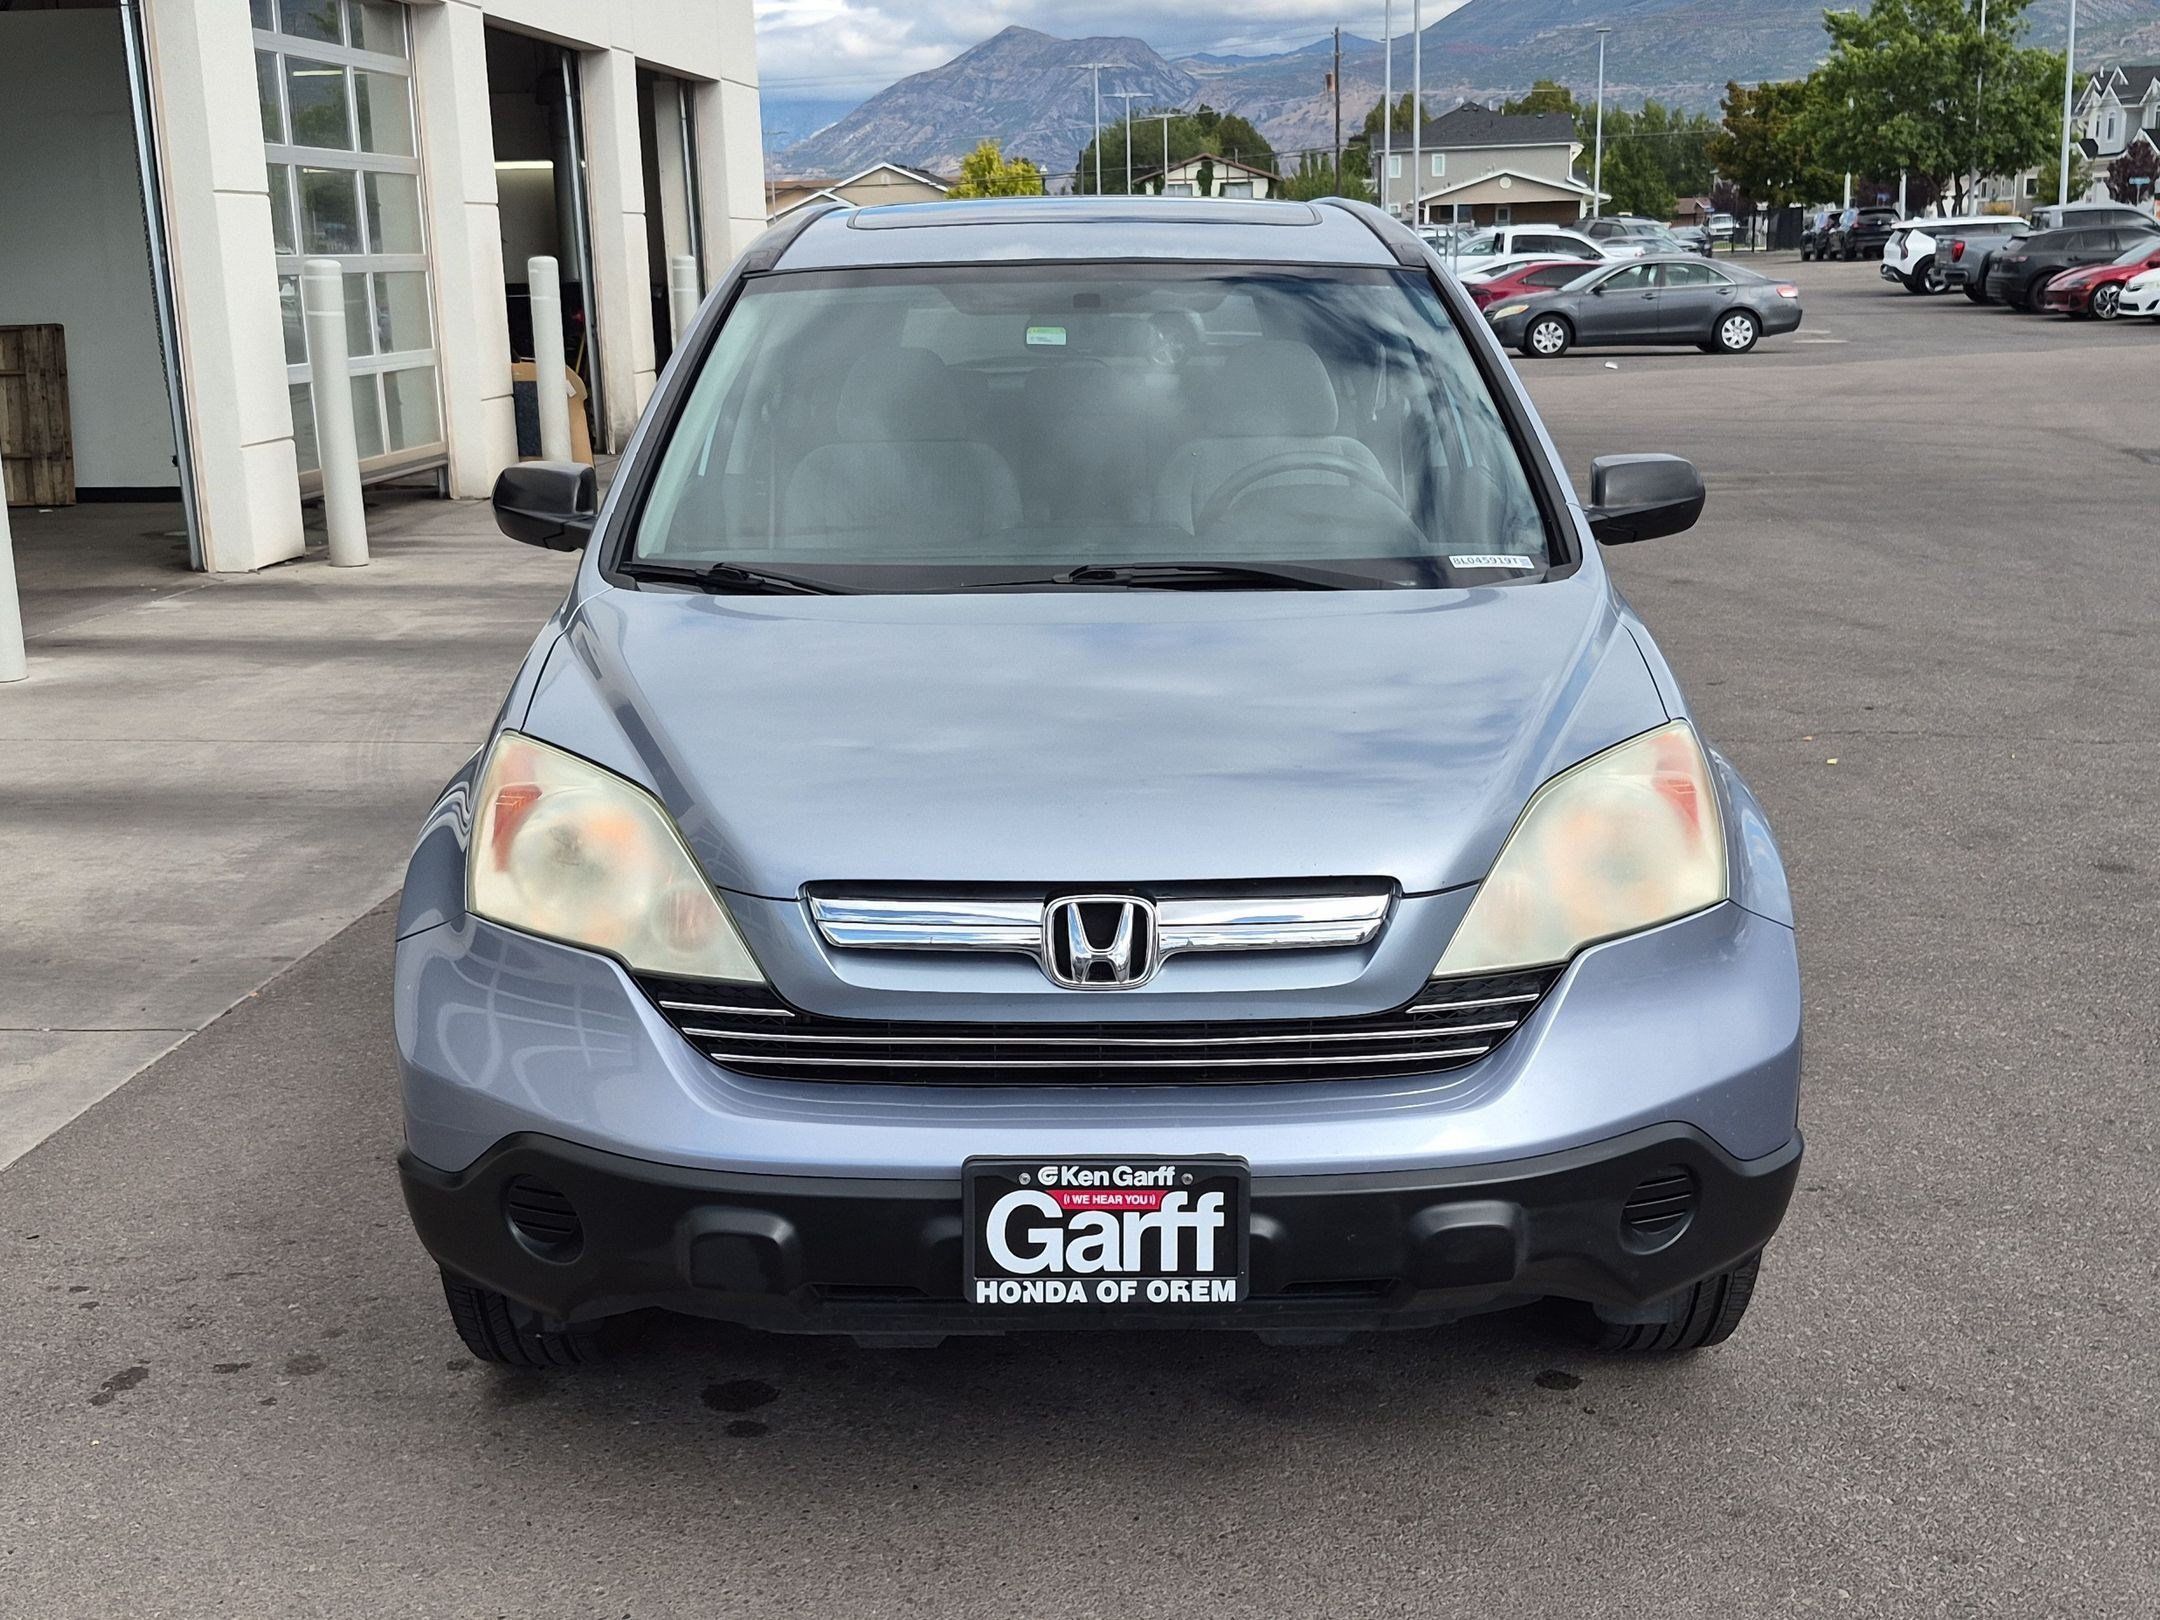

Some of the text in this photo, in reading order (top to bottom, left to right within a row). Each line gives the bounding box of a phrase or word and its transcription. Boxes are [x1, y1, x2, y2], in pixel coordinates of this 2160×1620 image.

[1061, 1166, 1110, 1186] Ken
[1112, 1165, 1176, 1187] Garff
[1072, 1194, 1148, 1205] WE HEAR YOU
[985, 1189, 1225, 1275] Garff
[976, 1280, 1237, 1304] HONDA OF OREM
